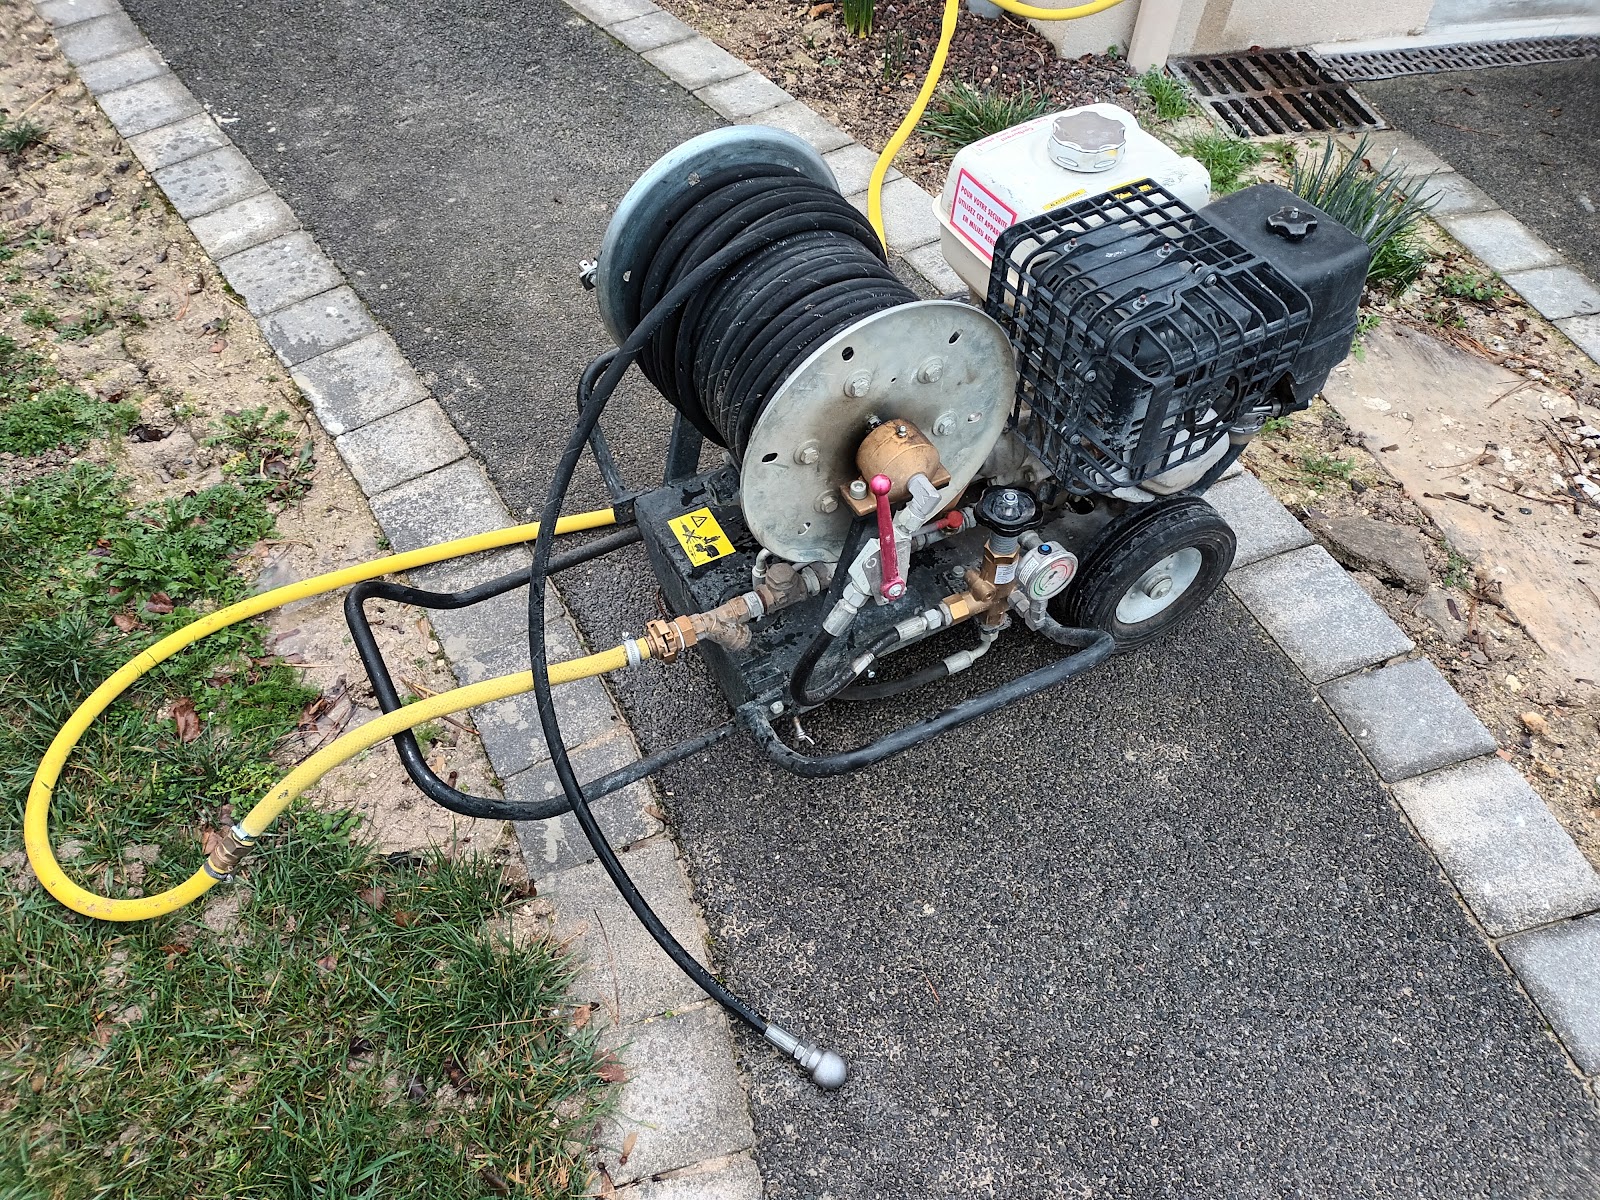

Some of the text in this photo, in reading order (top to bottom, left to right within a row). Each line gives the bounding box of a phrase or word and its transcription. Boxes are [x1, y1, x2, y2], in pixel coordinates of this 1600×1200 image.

[958, 197, 976, 216] UTILISEZ
[976, 212, 985, 222] CET
[961, 185, 1008, 229] POUR VOTRE SECURITE
[962, 214, 969, 223] EN
[969, 220, 985, 237] MILIEU
